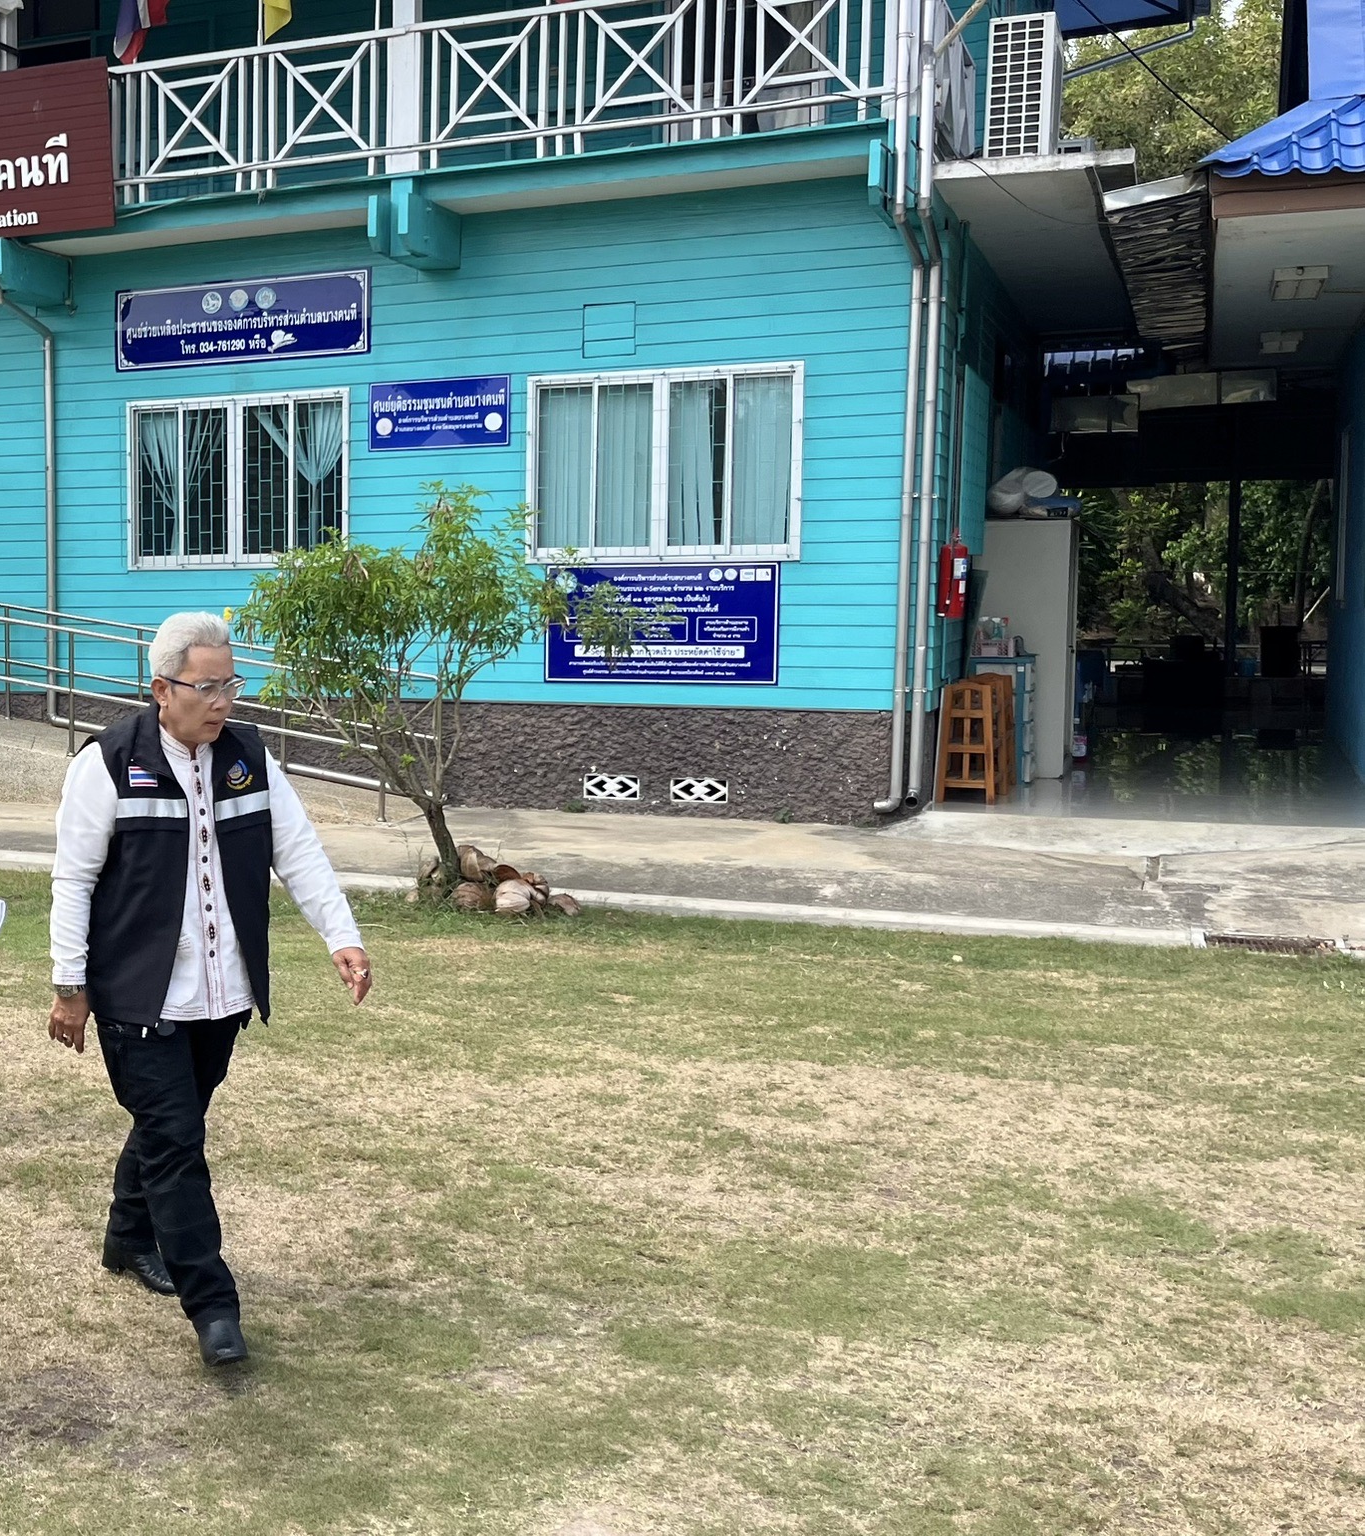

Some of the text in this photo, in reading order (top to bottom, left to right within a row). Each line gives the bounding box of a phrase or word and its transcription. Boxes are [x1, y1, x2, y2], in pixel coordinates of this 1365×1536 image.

[126, 303, 357, 344] ศูนย์ช่วยเหลือประชาชนขององค์การบริหารส่วนตำบลบางคนที
[199, 338, 246, 353] 034-761290
[249, 334, 267, 349] หรือ
[373, 388, 505, 417] ศูนย์ยุติธรรมชุมชนตำบลบางคนที
